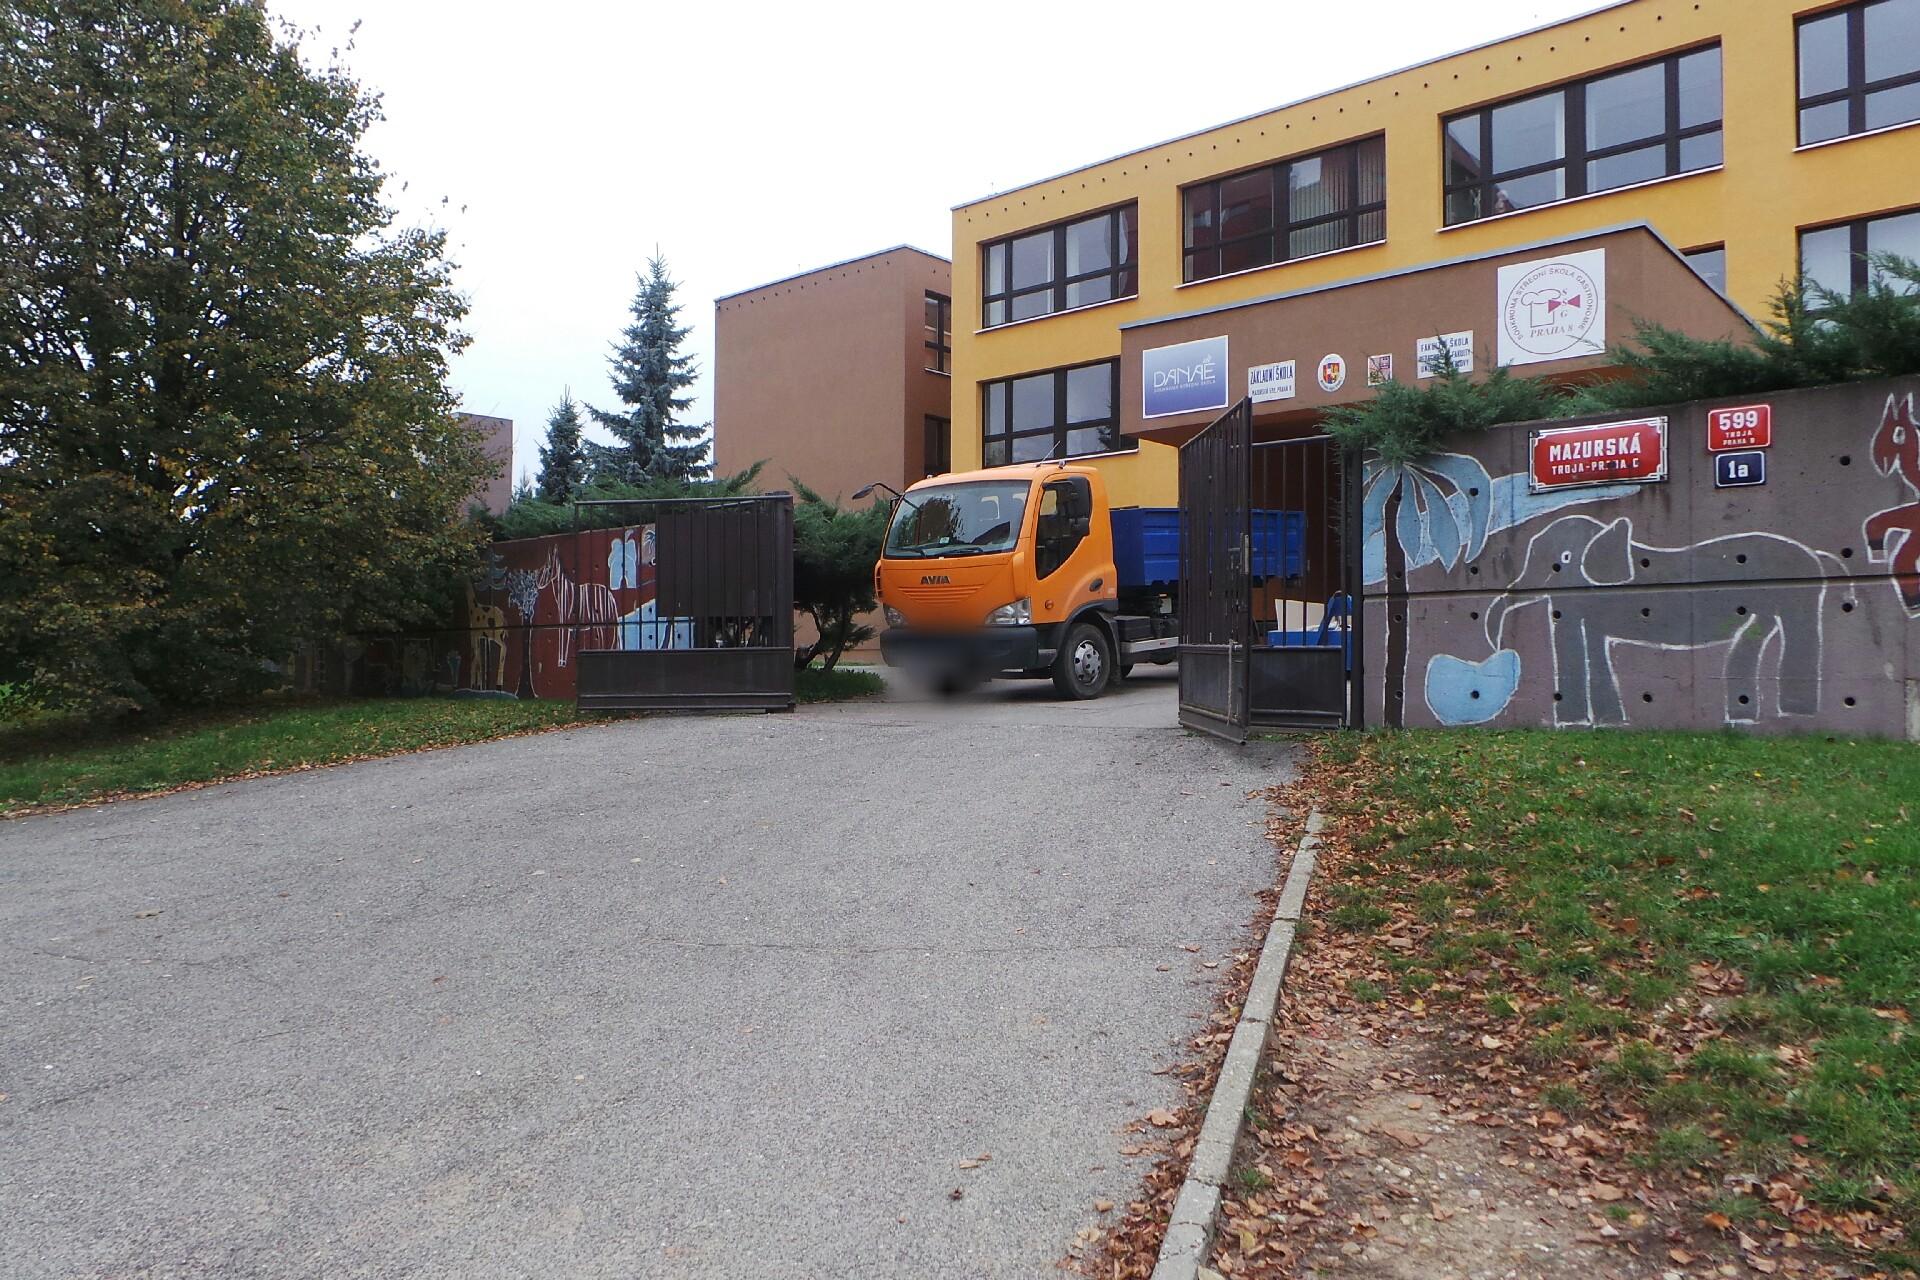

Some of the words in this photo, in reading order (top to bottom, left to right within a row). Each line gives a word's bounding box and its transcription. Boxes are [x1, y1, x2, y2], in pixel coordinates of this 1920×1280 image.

[1530, 325, 1566, 338] PRAHA
[1450, 337, 1469, 348] ŠKOLA
[1250, 365, 1275, 385] ZÁKLADNÍ
[1275, 364, 1294, 381] ŠKOLA
[1719, 410, 1758, 431] 599
[1725, 429, 1753, 438] TROJA
[1549, 432, 1641, 462] MAZURSKÁ
[1722, 438, 1747, 446] PRAHA
[1728, 460, 1749, 479] 1a
[920, 575, 951, 585] AVIA
